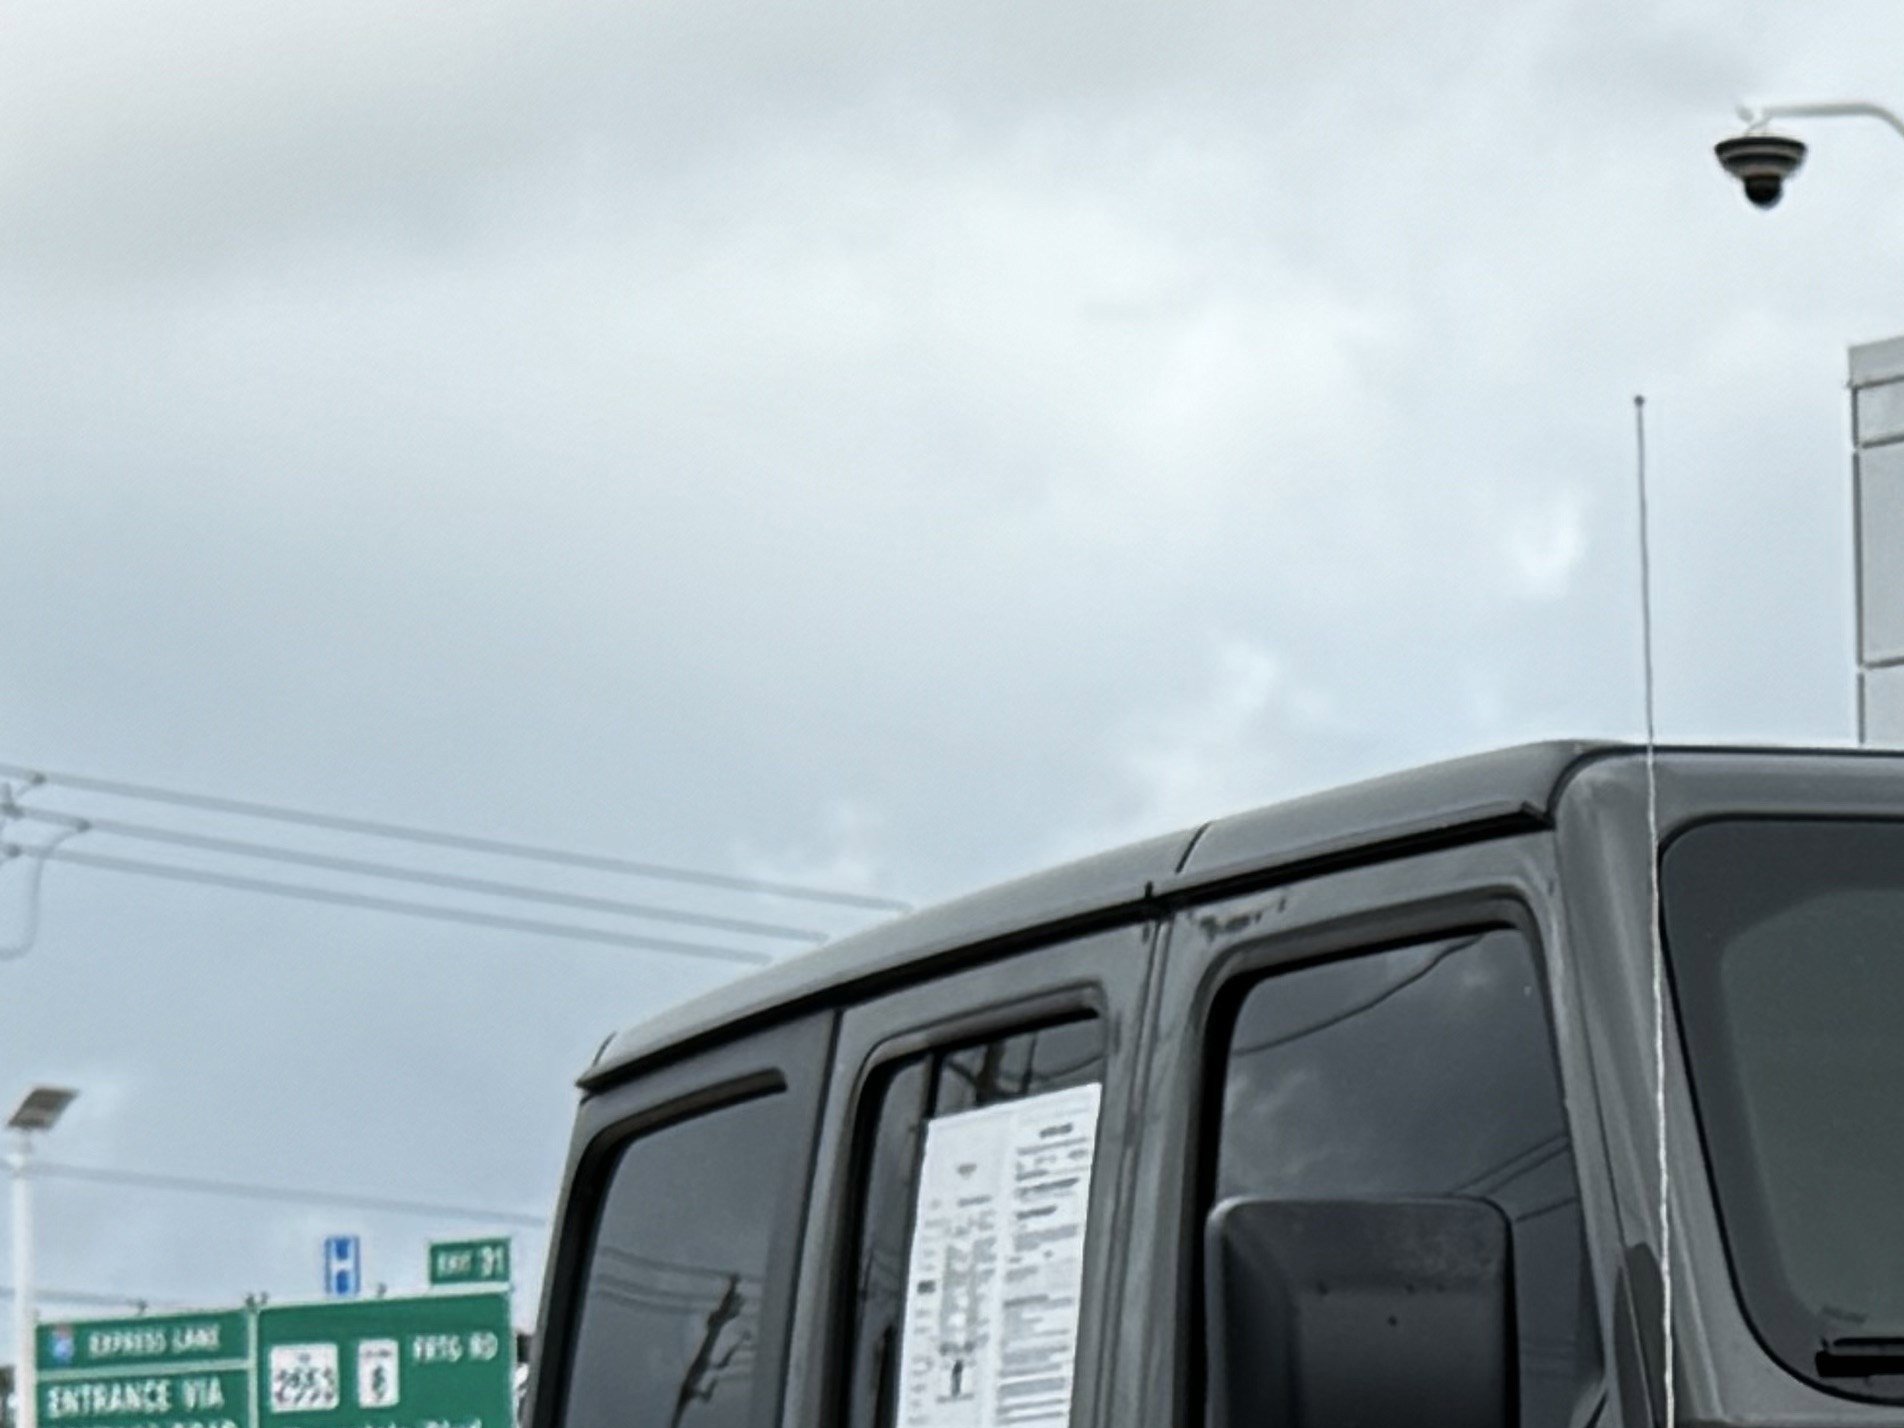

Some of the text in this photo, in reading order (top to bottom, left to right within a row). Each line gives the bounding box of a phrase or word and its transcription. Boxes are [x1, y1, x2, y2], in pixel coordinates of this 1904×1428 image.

[88, 1323, 221, 1358] EXPRESS LANE
[468, 1331, 499, 1361] RD
[47, 1376, 225, 1418] ENTRANCE VIA
